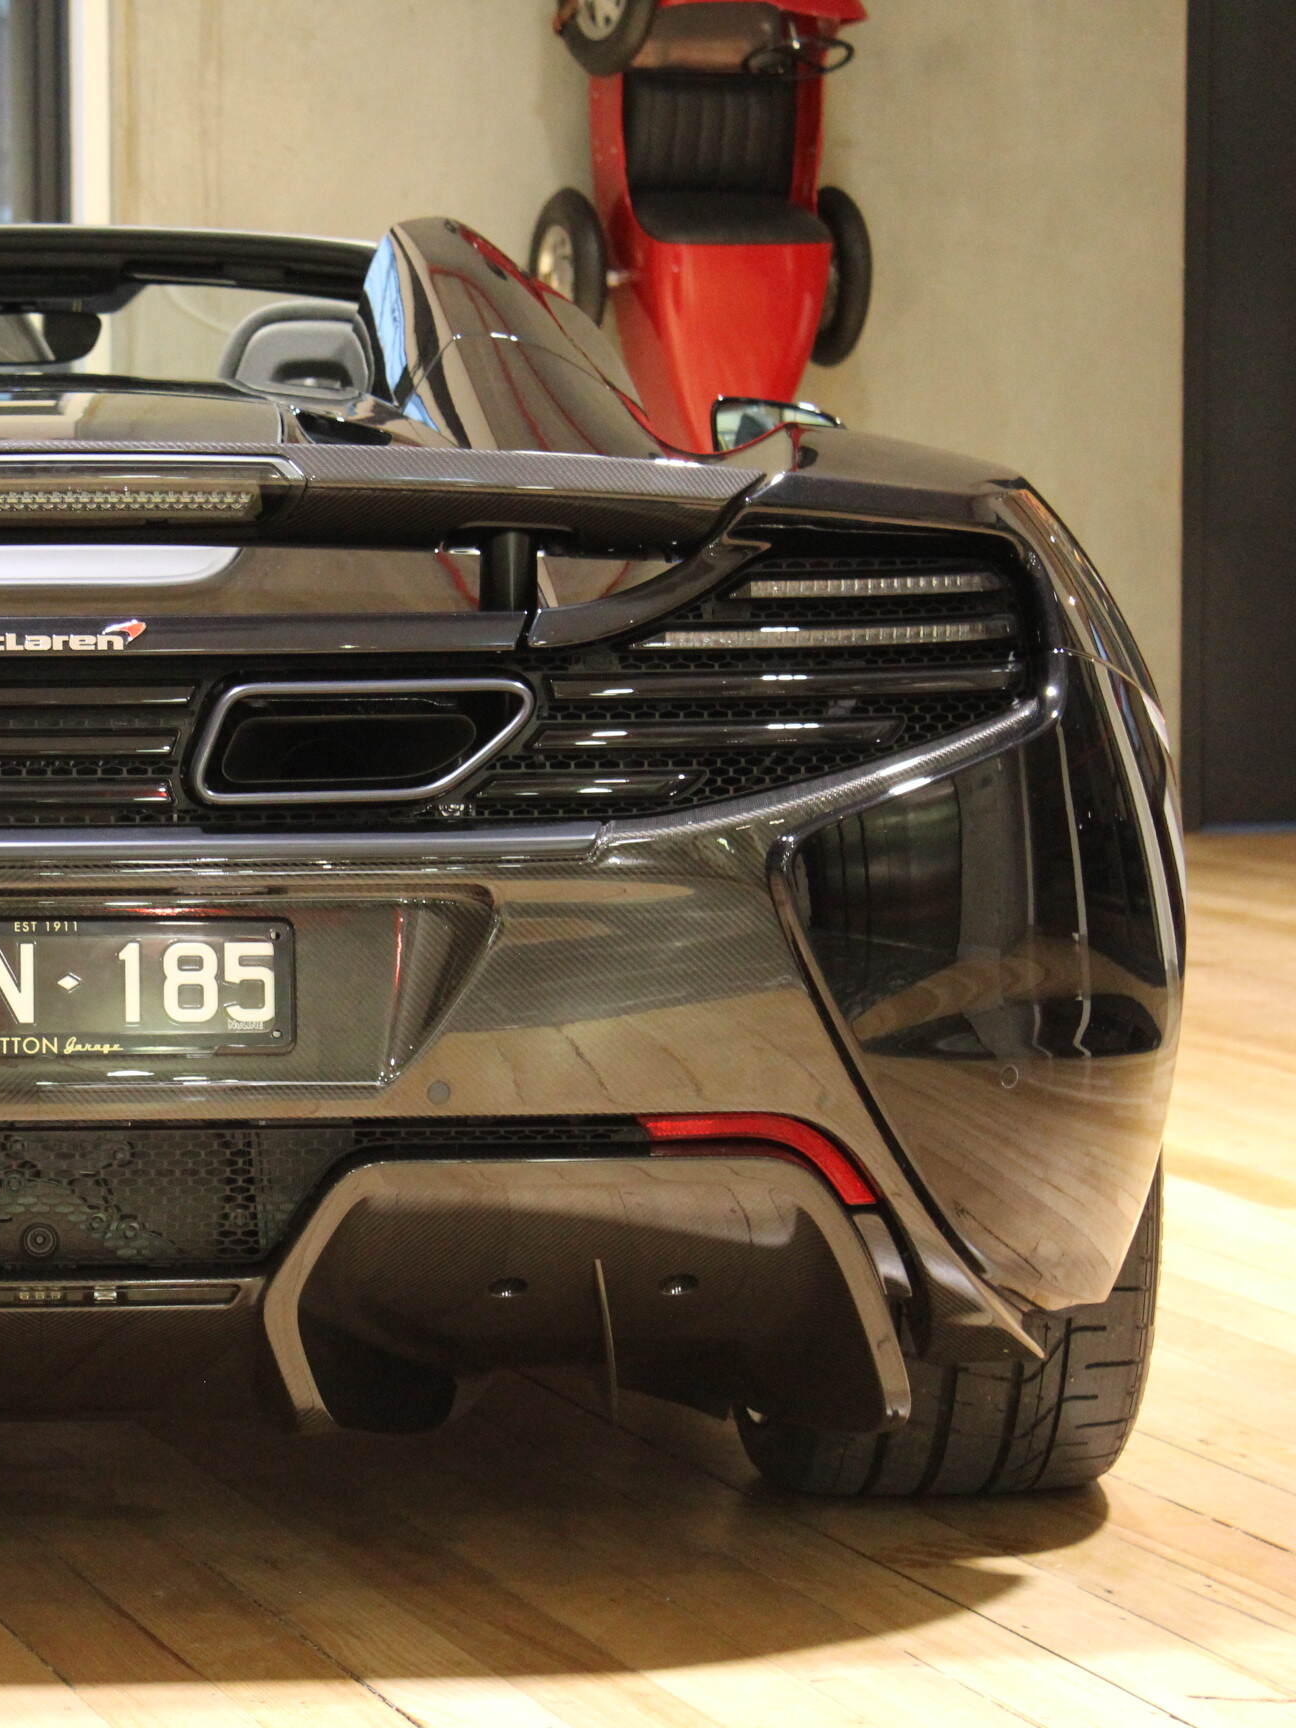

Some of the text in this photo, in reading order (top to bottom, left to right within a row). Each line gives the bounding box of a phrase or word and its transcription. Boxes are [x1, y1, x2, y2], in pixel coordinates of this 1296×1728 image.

[13, 920, 78, 933] EST 1911
[116, 941, 275, 1025] 185
[63, 1036, 125, 1055] Garage
